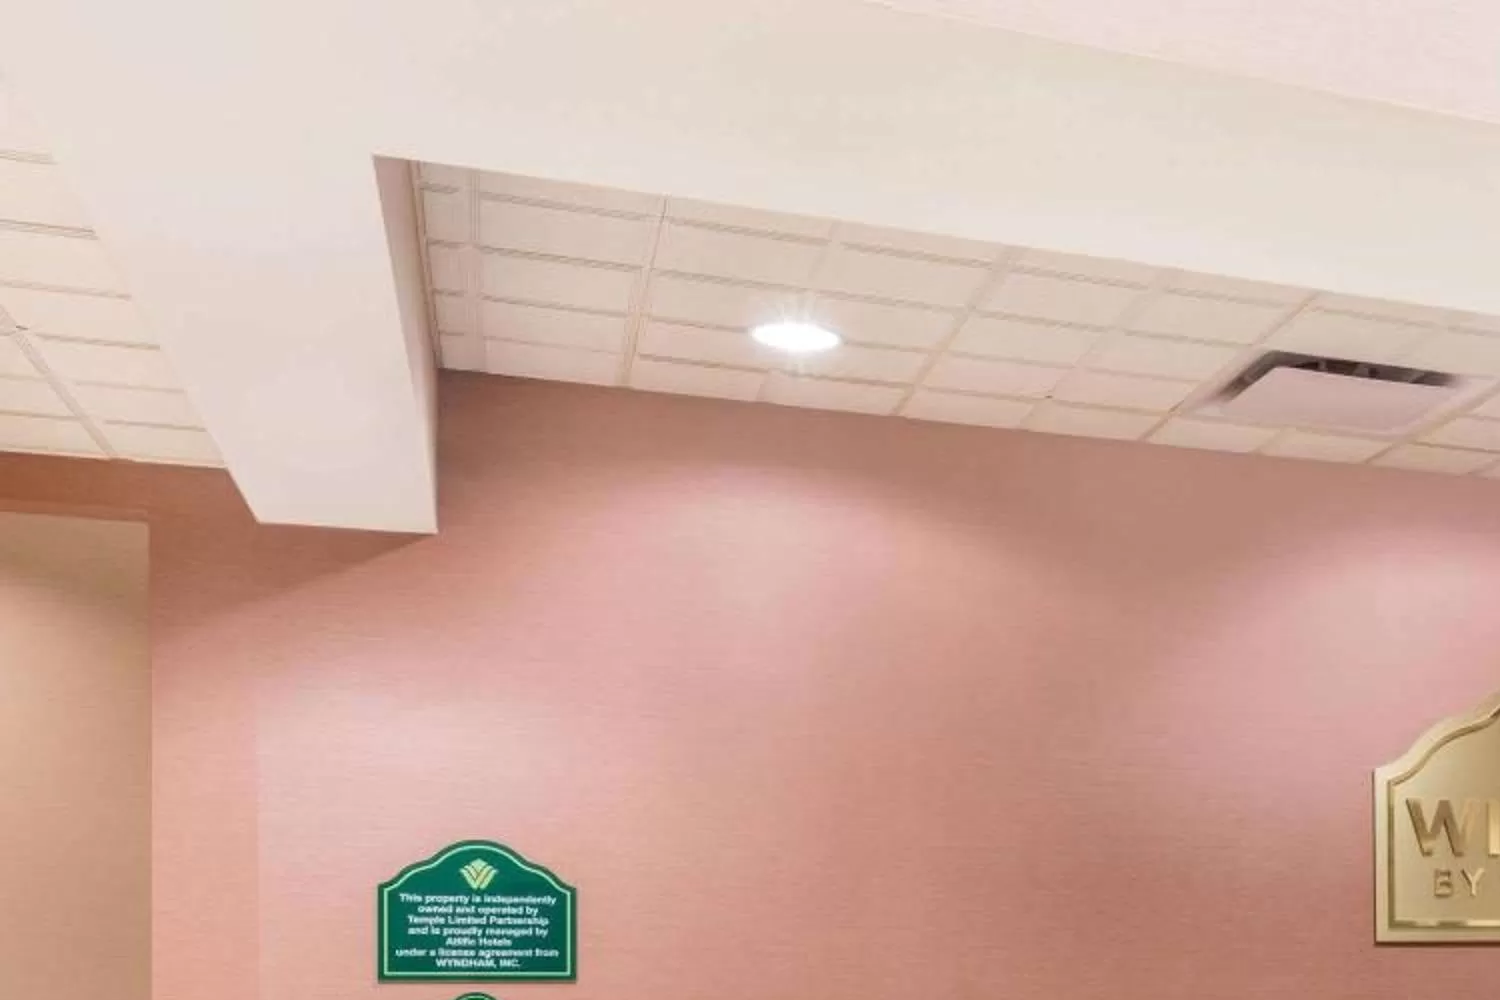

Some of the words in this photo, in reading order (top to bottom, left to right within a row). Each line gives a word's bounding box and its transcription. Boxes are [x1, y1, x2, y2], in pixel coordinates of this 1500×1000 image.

[1432, 868, 1486, 898] BY
[399, 893, 423, 903] This
[425, 894, 470, 905] property
[472, 893, 482, 903] is
[484, 894, 557, 906] independently
[417, 905, 453, 914] owned
[455, 905, 476, 914] and
[478, 905, 524, 916] operated
[526, 905, 539, 917] by
[407, 914, 446, 926] Temple
[448, 915, 487, 925] Limited
[489, 915, 549, 927] Partnership
[408, 926, 429, 935] and
[431, 926, 441, 935] is
[443, 926, 483, 937] proudly
[485, 927, 533, 938] managed
[535, 927, 549, 938] by
[479, 937, 513, 947] Hotels
[395, 948, 427, 957] under
[429, 949, 436, 957] a
[478, 949, 533, 959] agreement
[535, 947, 559, 957] from
